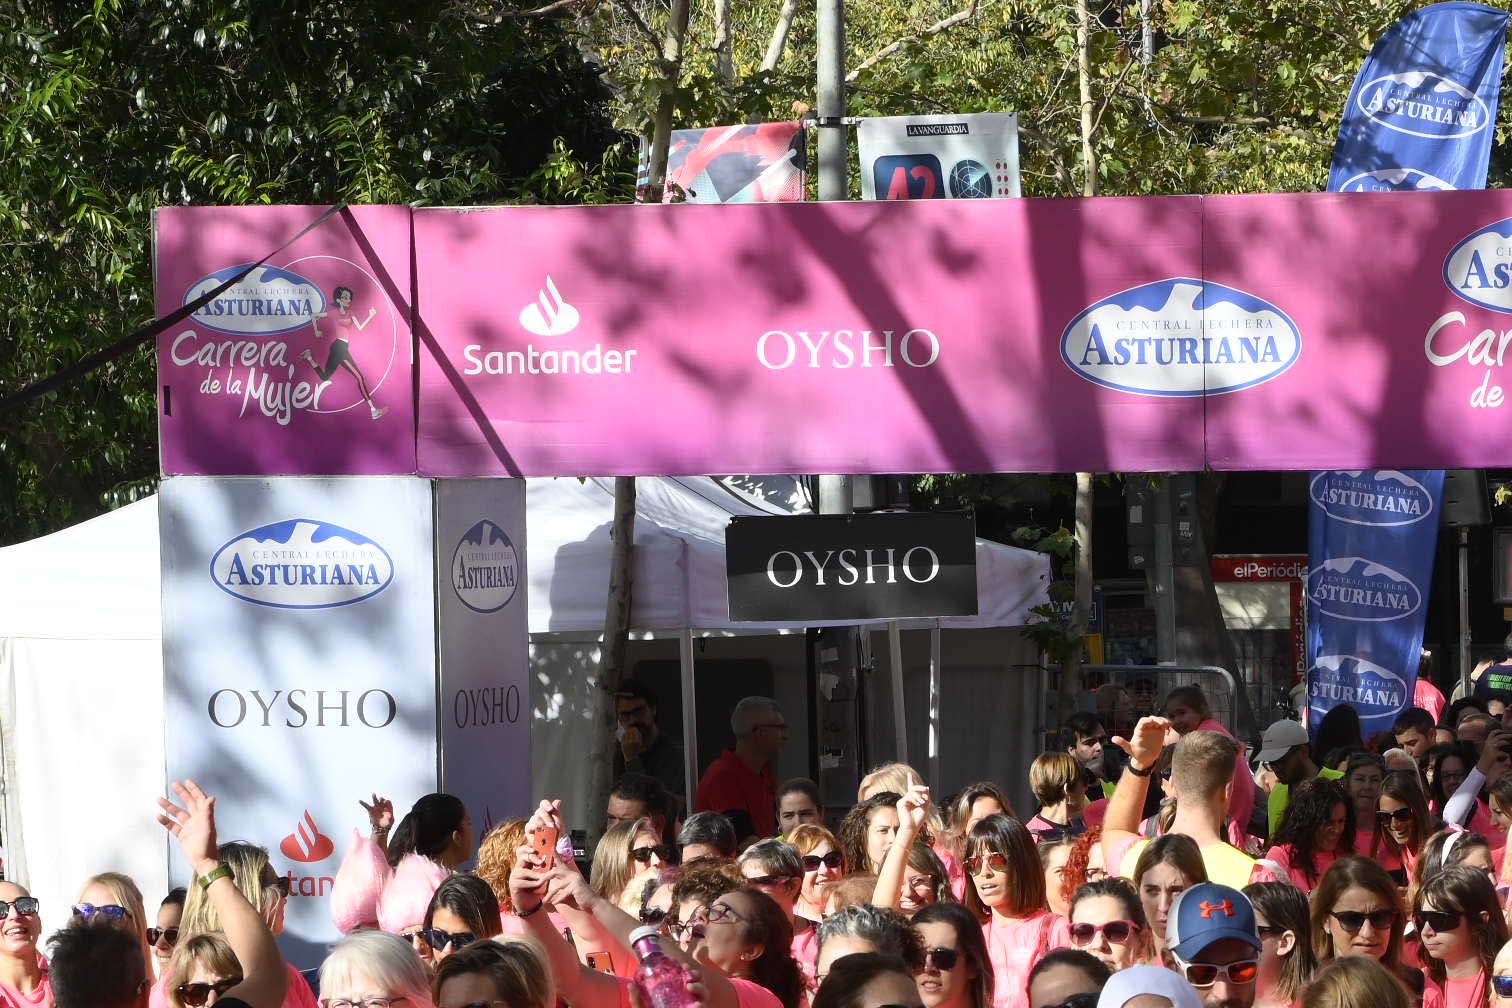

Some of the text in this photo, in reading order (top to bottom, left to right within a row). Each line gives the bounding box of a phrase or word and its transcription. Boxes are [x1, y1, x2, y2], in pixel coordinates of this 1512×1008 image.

[1367, 87, 1477, 128] ASTURIANA
[908, 124, 968, 135] LA VANGUARDIA
[193, 291, 314, 317] ASTURIANA
[1116, 316, 1274, 331] CENTRAL LECHERA
[170, 330, 288, 367] Carrera
[463, 342, 638, 376] Santander
[756, 329, 941, 370] OYSHO
[1080, 328, 1282, 367] ASTURIANA
[200, 364, 332, 426] de la Mujer
[1470, 368, 1504, 408] de
[1319, 481, 1422, 516] ASTURIANA
[224, 551, 381, 587] ASTURIANA
[252, 550, 312, 560] CENTRAL
[766, 546, 941, 588] OYSHO
[1233, 561, 1308, 579] elPeriódi
[456, 555, 515, 592] ASTURIANA
[1313, 575, 1410, 610] ASTURIANA
[207, 688, 398, 729] OYSHO
[453, 684, 521, 729] OYSHO
[1309, 681, 1400, 707] STURIANA
